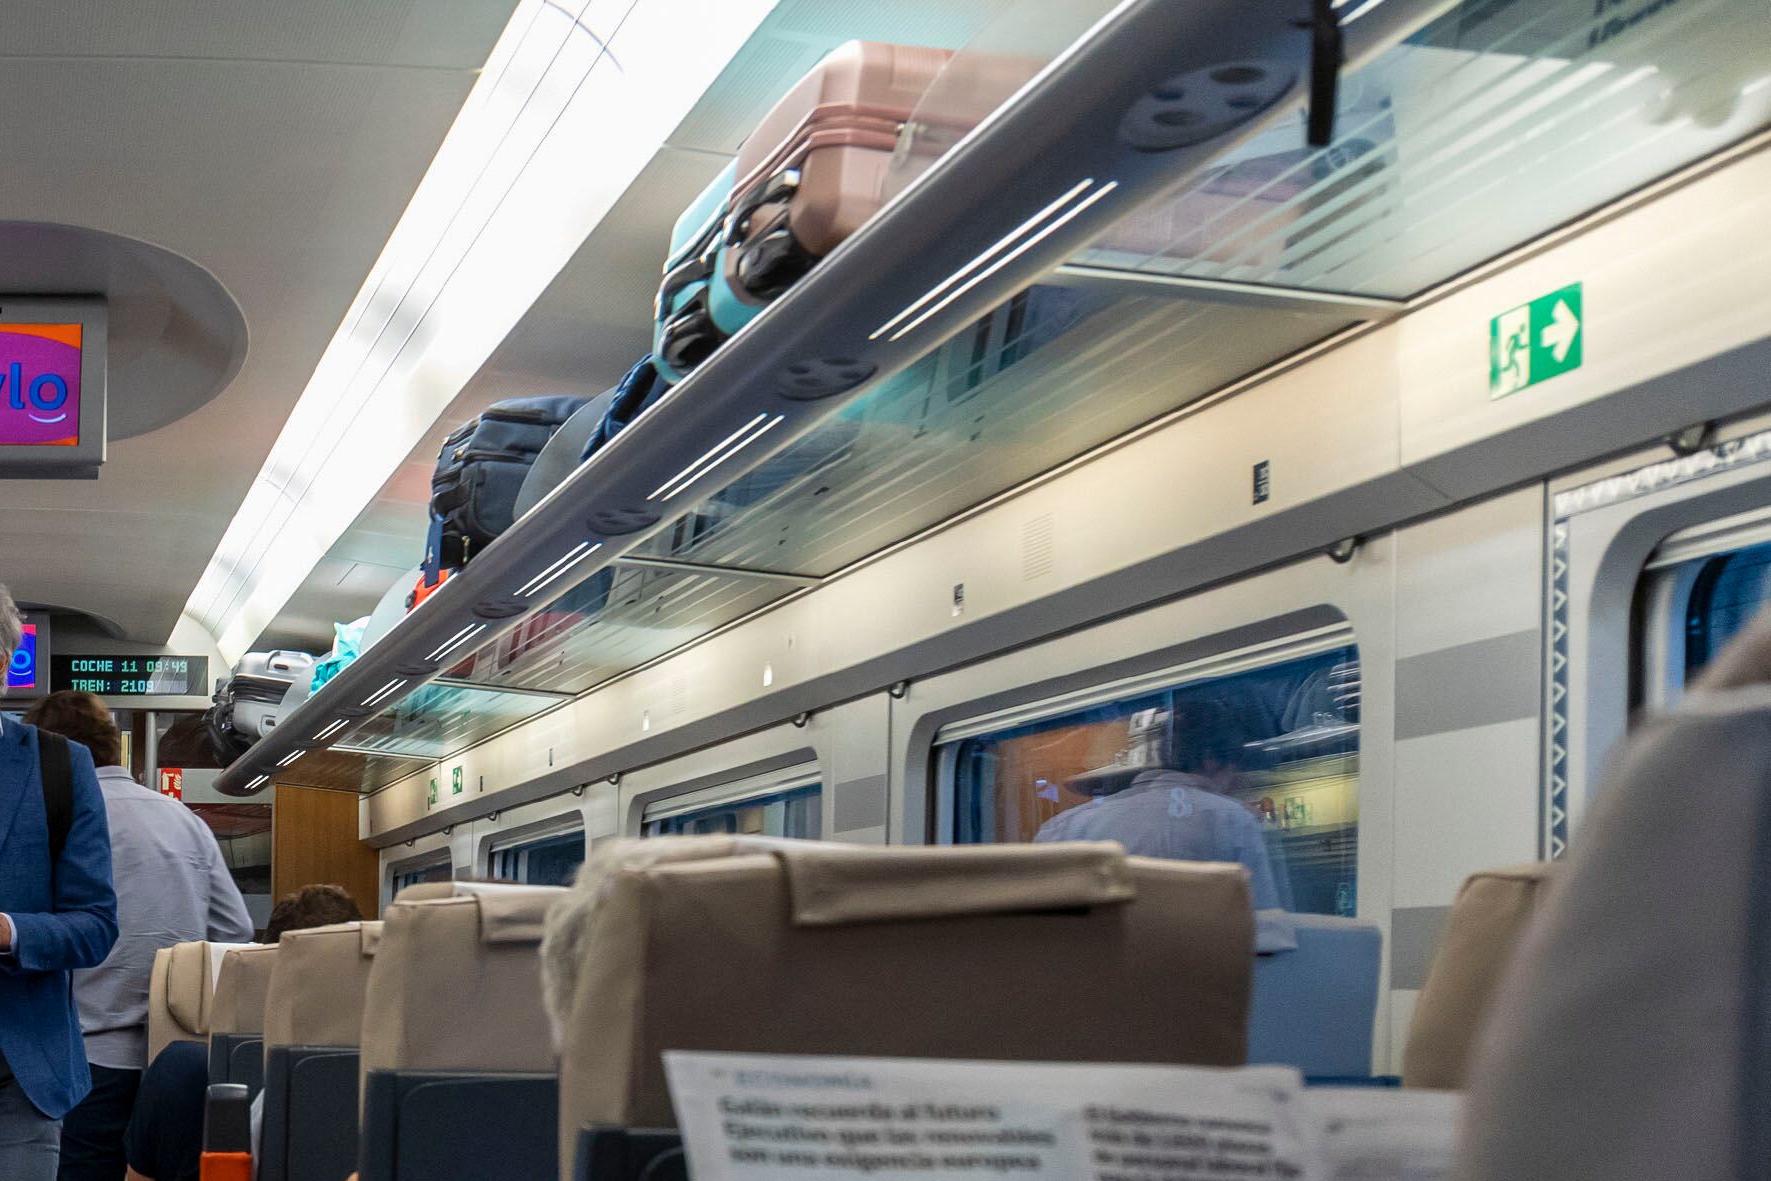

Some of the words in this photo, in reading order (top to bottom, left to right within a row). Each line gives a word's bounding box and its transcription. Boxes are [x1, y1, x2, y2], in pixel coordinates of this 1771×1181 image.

[71, 660, 113, 672] COCHE
[121, 660, 138, 672] 11
[71, 679, 111, 692] TREN:
[121, 680, 154, 692] 2109
